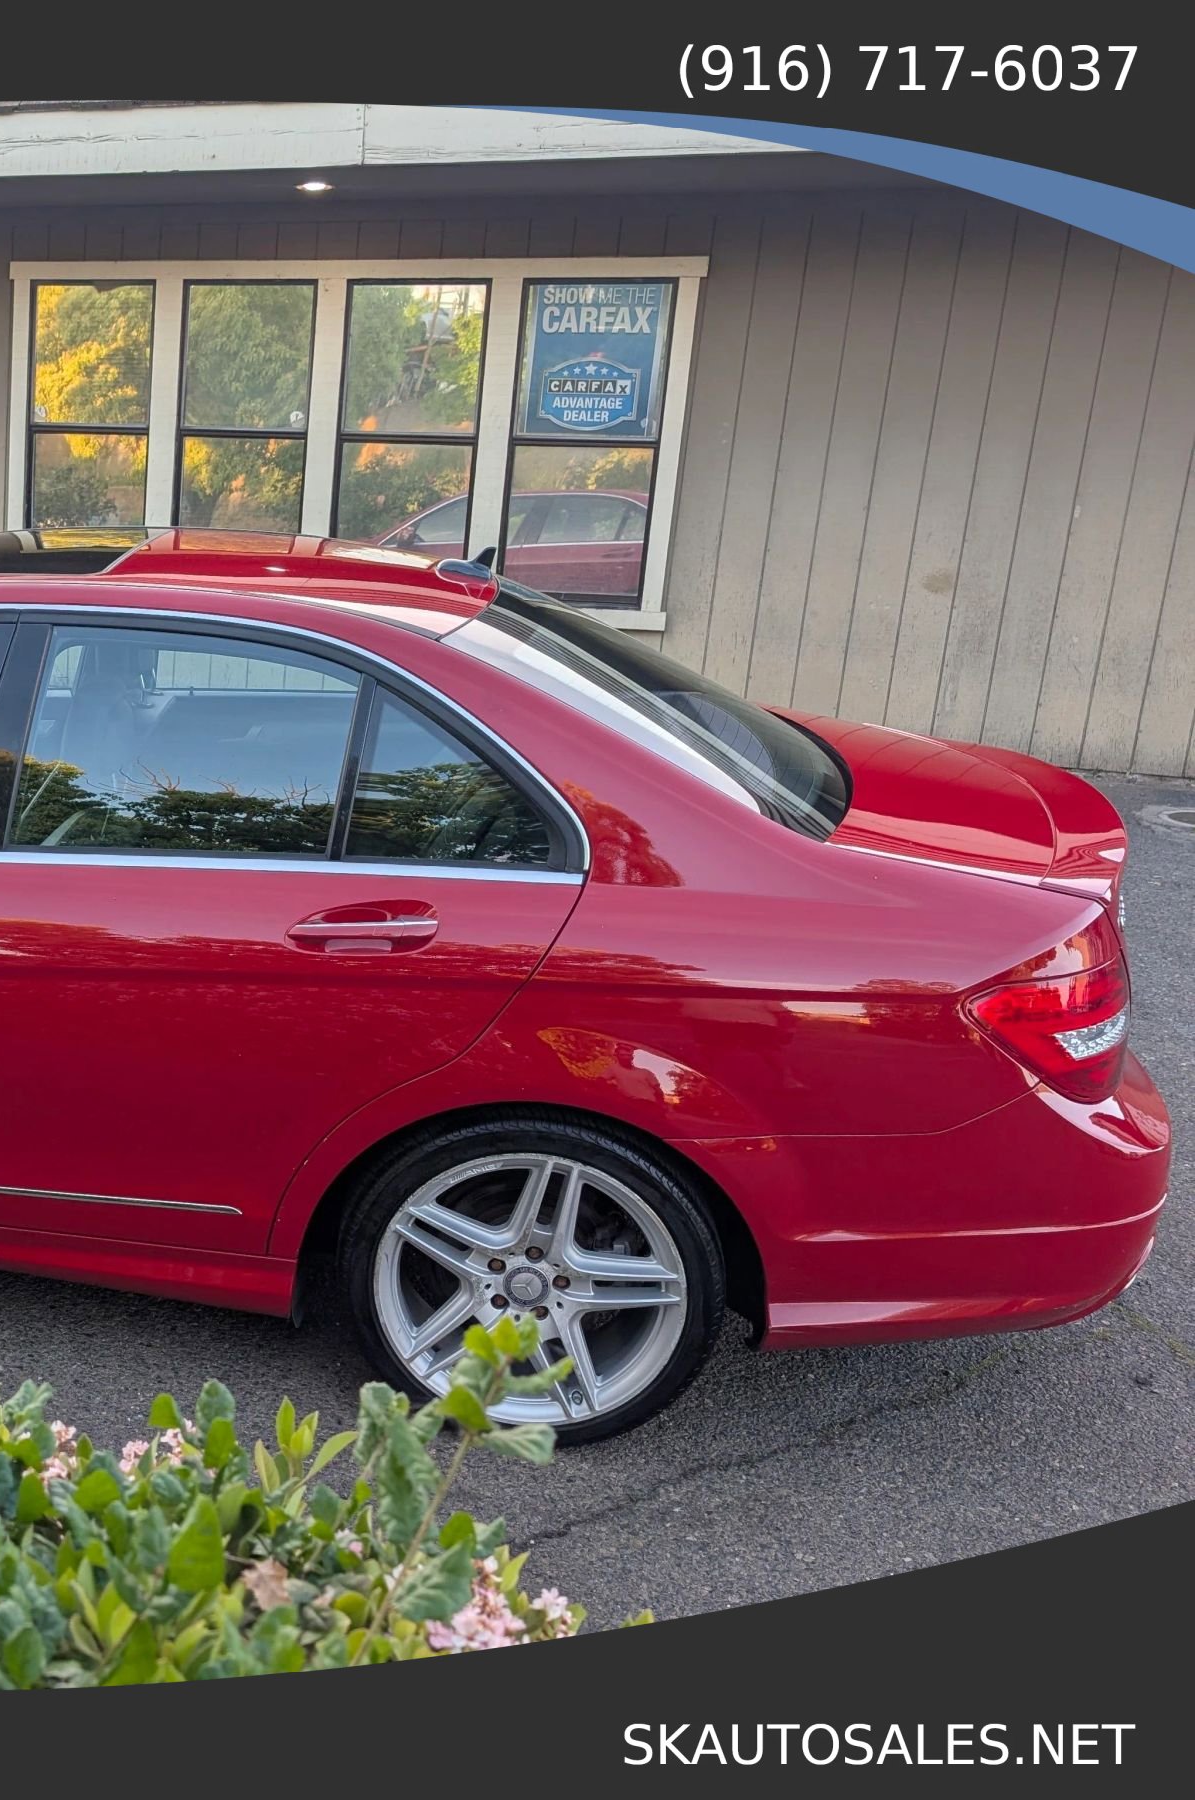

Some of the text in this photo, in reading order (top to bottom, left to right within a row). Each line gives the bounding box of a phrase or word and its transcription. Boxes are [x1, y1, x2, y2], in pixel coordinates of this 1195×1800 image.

[544, 287, 656, 304] SHOW ME THE
[542, 306, 653, 333] CARFAX
[550, 380, 628, 394] CARFAX
[552, 396, 623, 409] ADVANTAGE
[564, 410, 609, 422] DEALER
